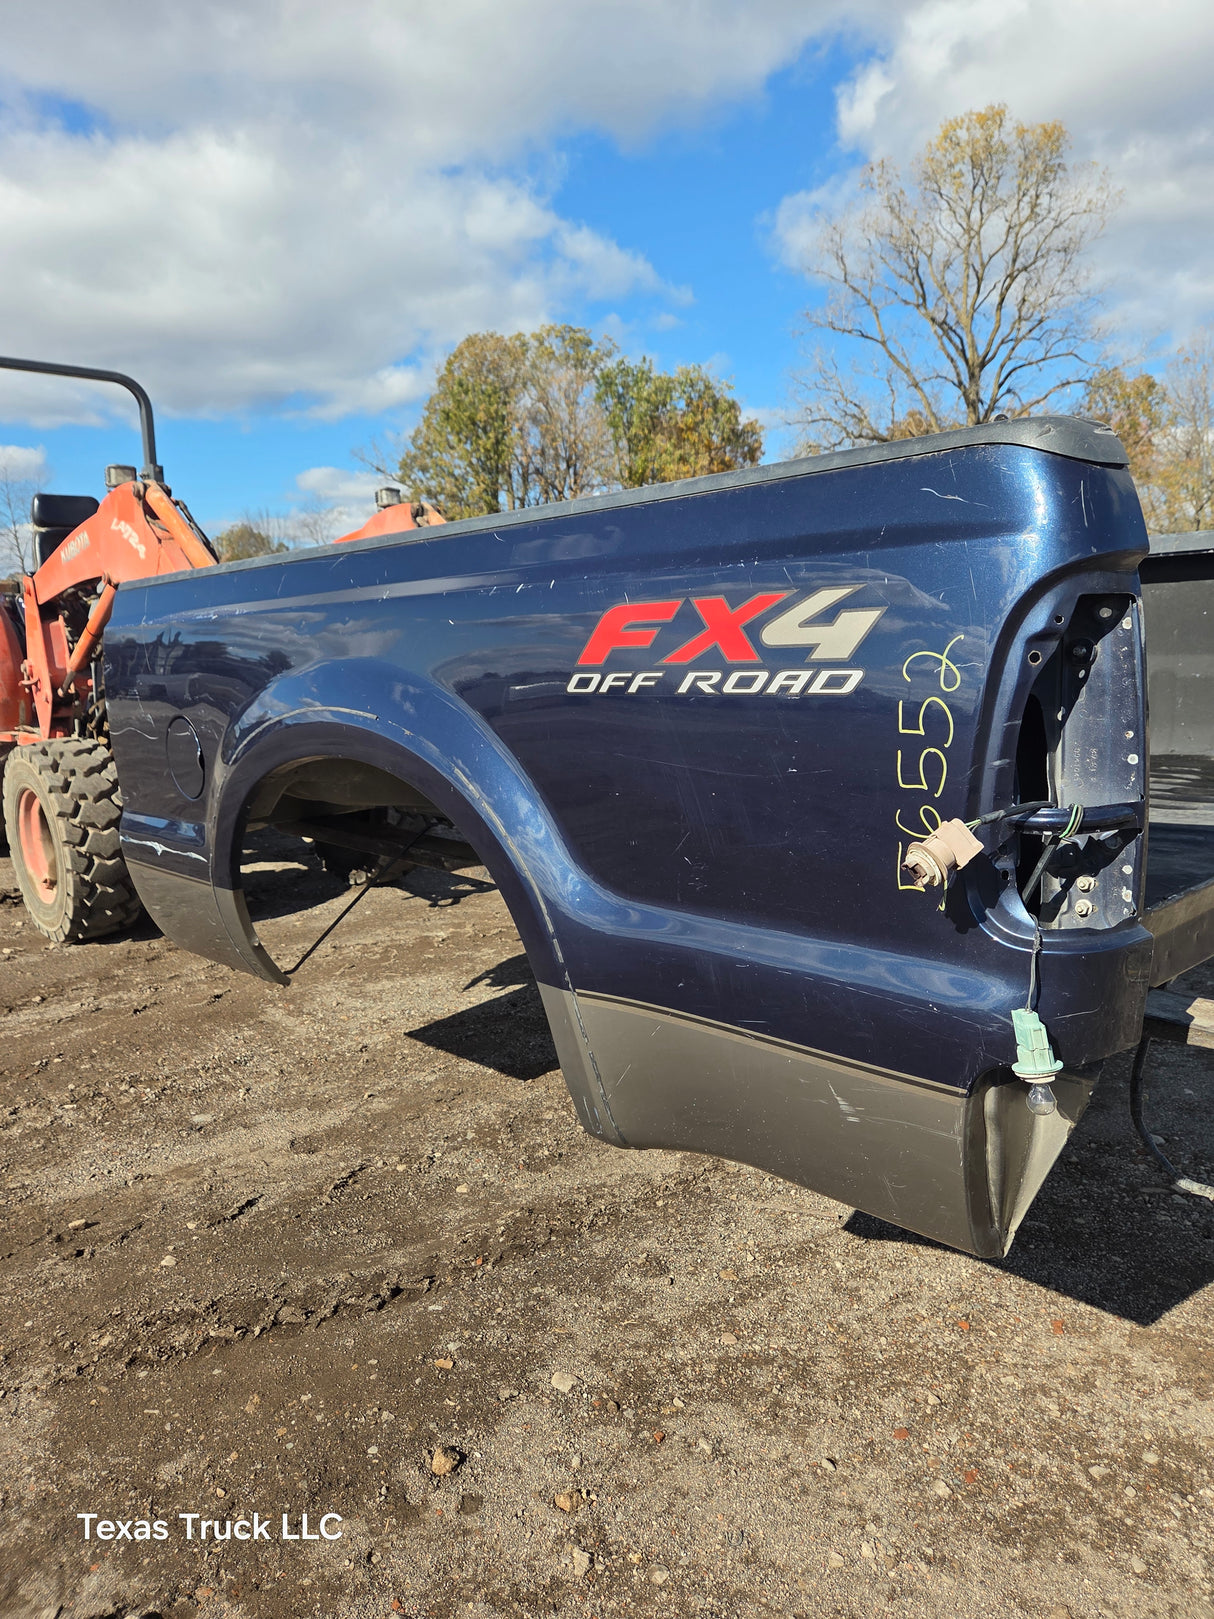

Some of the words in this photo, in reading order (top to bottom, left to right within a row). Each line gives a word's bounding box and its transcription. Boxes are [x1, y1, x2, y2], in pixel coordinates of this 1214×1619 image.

[60, 530, 90, 564] KUBOTA
[575, 583, 889, 666] FX4
[565, 670, 666, 697] OFF
[675, 668, 866, 697] ROAD
